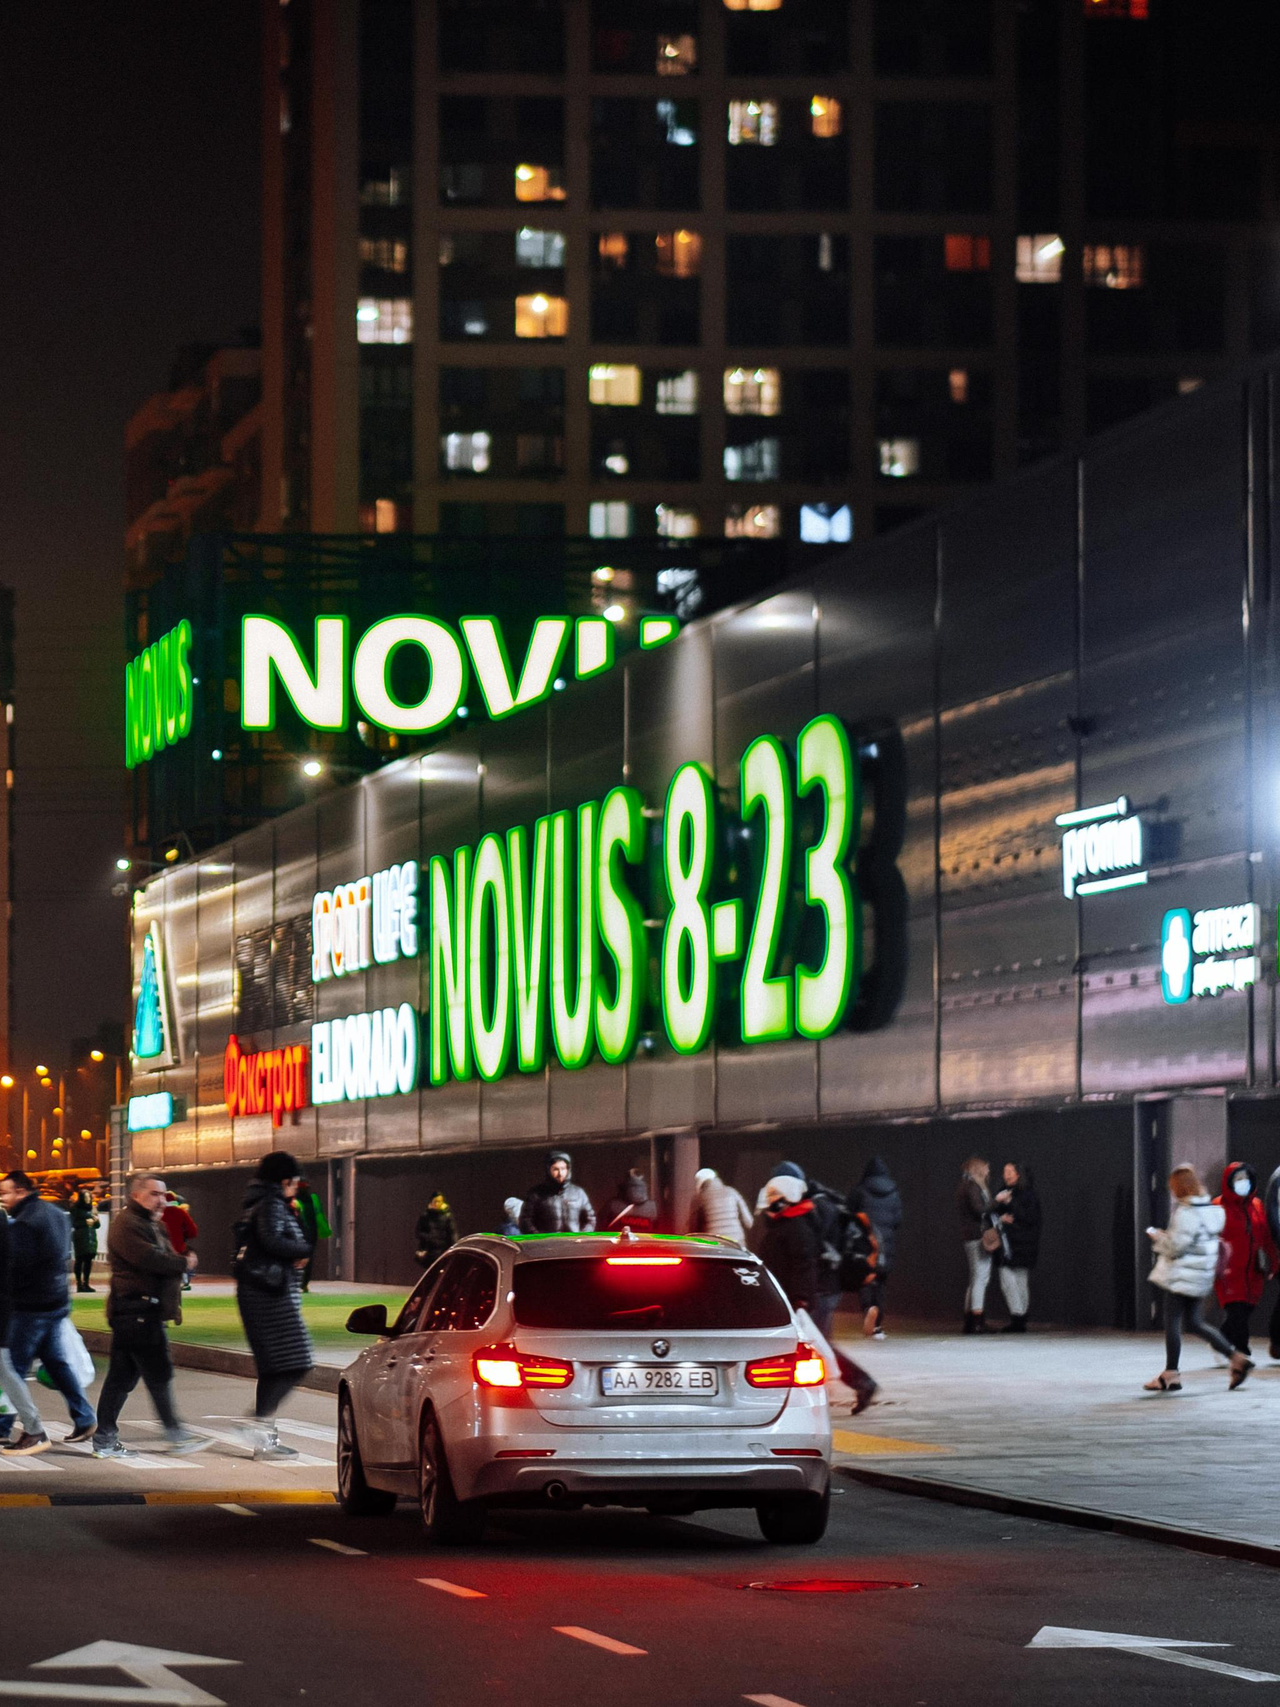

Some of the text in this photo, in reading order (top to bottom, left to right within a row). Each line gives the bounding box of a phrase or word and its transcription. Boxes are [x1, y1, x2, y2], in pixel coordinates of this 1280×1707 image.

[126, 618, 192, 769] NOVUS
[312, 860, 418, 982] SPORT LIFE
[430, 714, 854, 1086] NOVUS 8-23
[224, 1033, 306, 1129] Фокстрот
[311, 1002, 418, 1105] ELDORADO
[614, 1371, 714, 1389] AA 9282 EB
